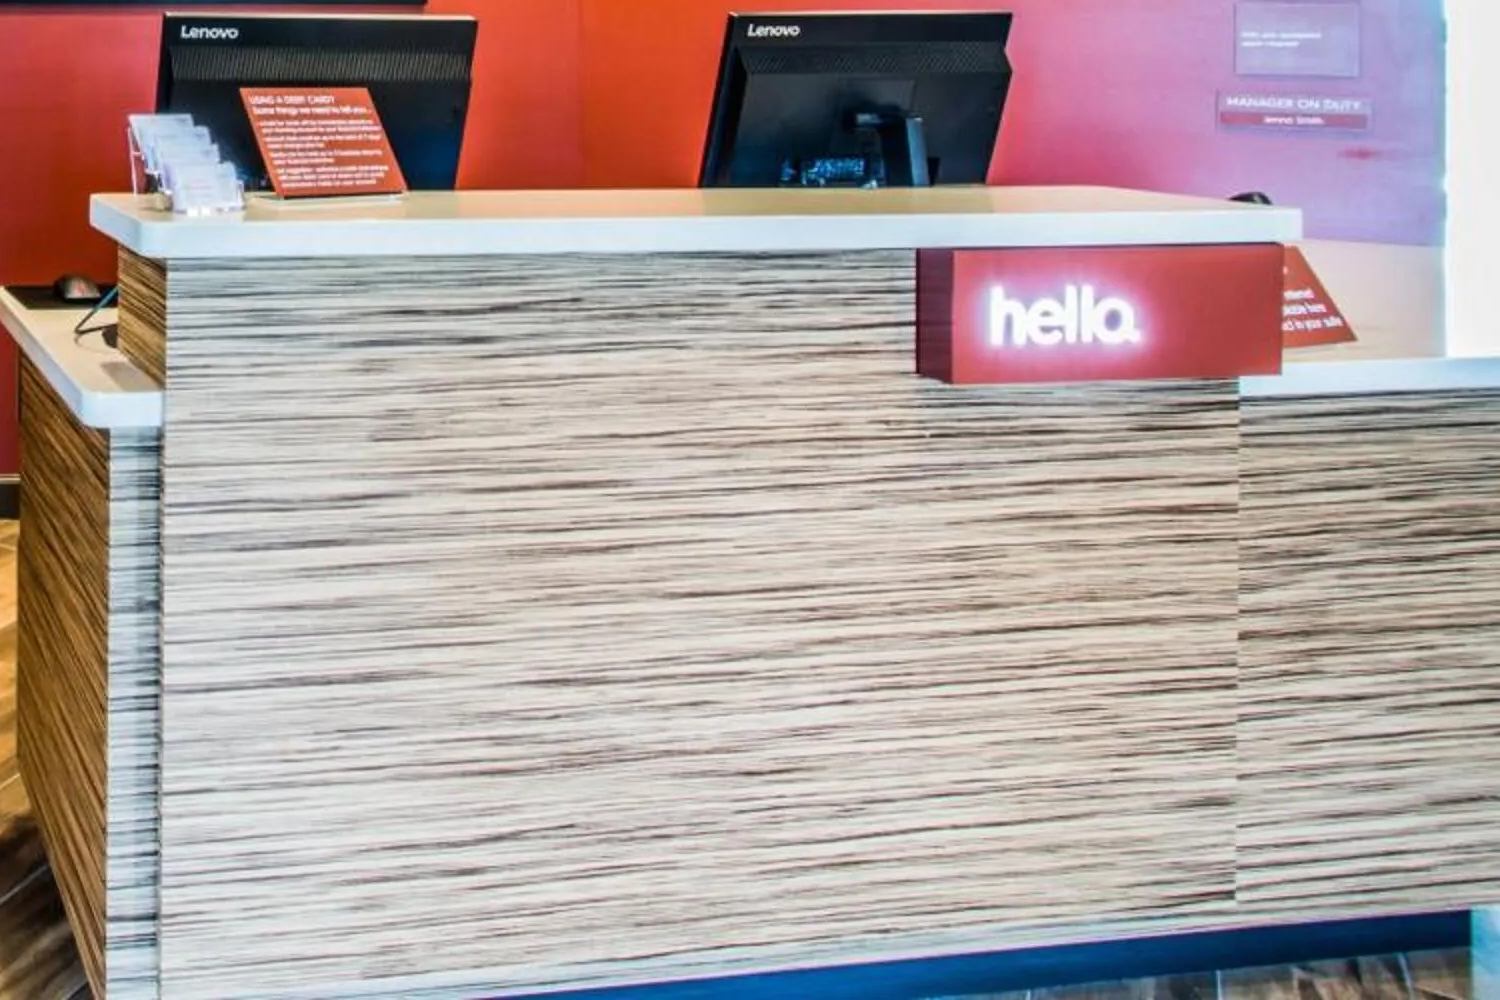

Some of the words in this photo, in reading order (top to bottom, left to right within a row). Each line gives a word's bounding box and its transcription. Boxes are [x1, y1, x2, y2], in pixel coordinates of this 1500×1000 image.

[180, 25, 239, 40] Lenovo
[747, 23, 800, 38] Lenovo
[1225, 96, 1293, 108] MANAGER
[1297, 97, 1320, 109] ON
